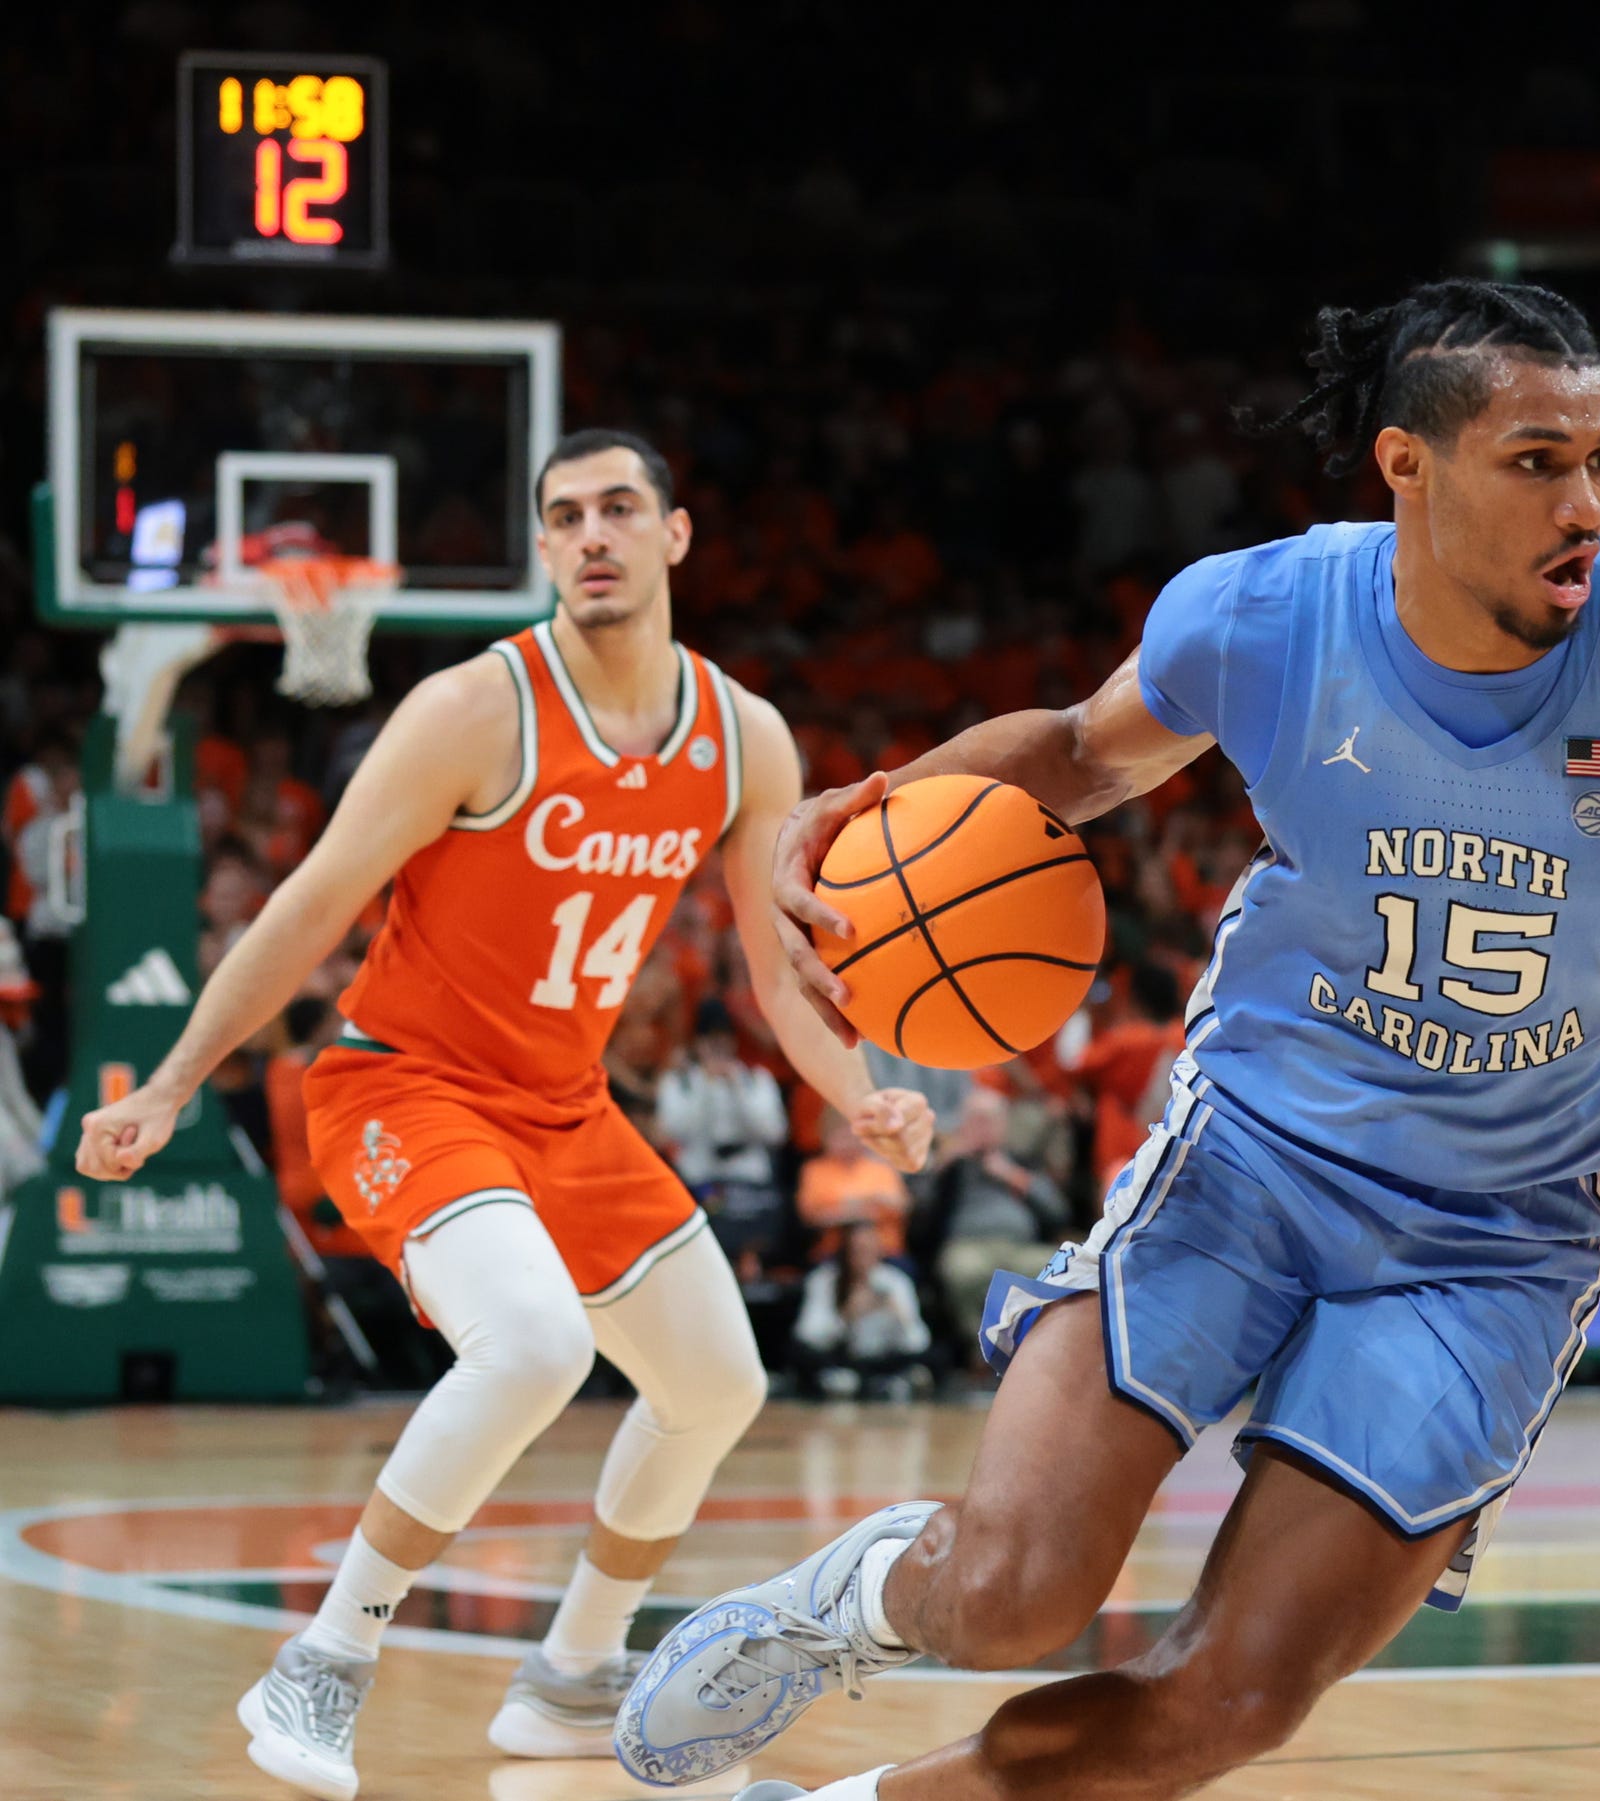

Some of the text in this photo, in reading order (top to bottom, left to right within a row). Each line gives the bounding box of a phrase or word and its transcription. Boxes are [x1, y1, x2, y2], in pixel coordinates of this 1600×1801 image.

[255, 138, 348, 245] 12
[524, 793, 702, 880] Canes
[1365, 828, 1569, 900] NORTH
[529, 890, 657, 1010] 14
[1364, 892, 1557, 1018] 15
[1309, 972, 1585, 1075] CAROLINA
